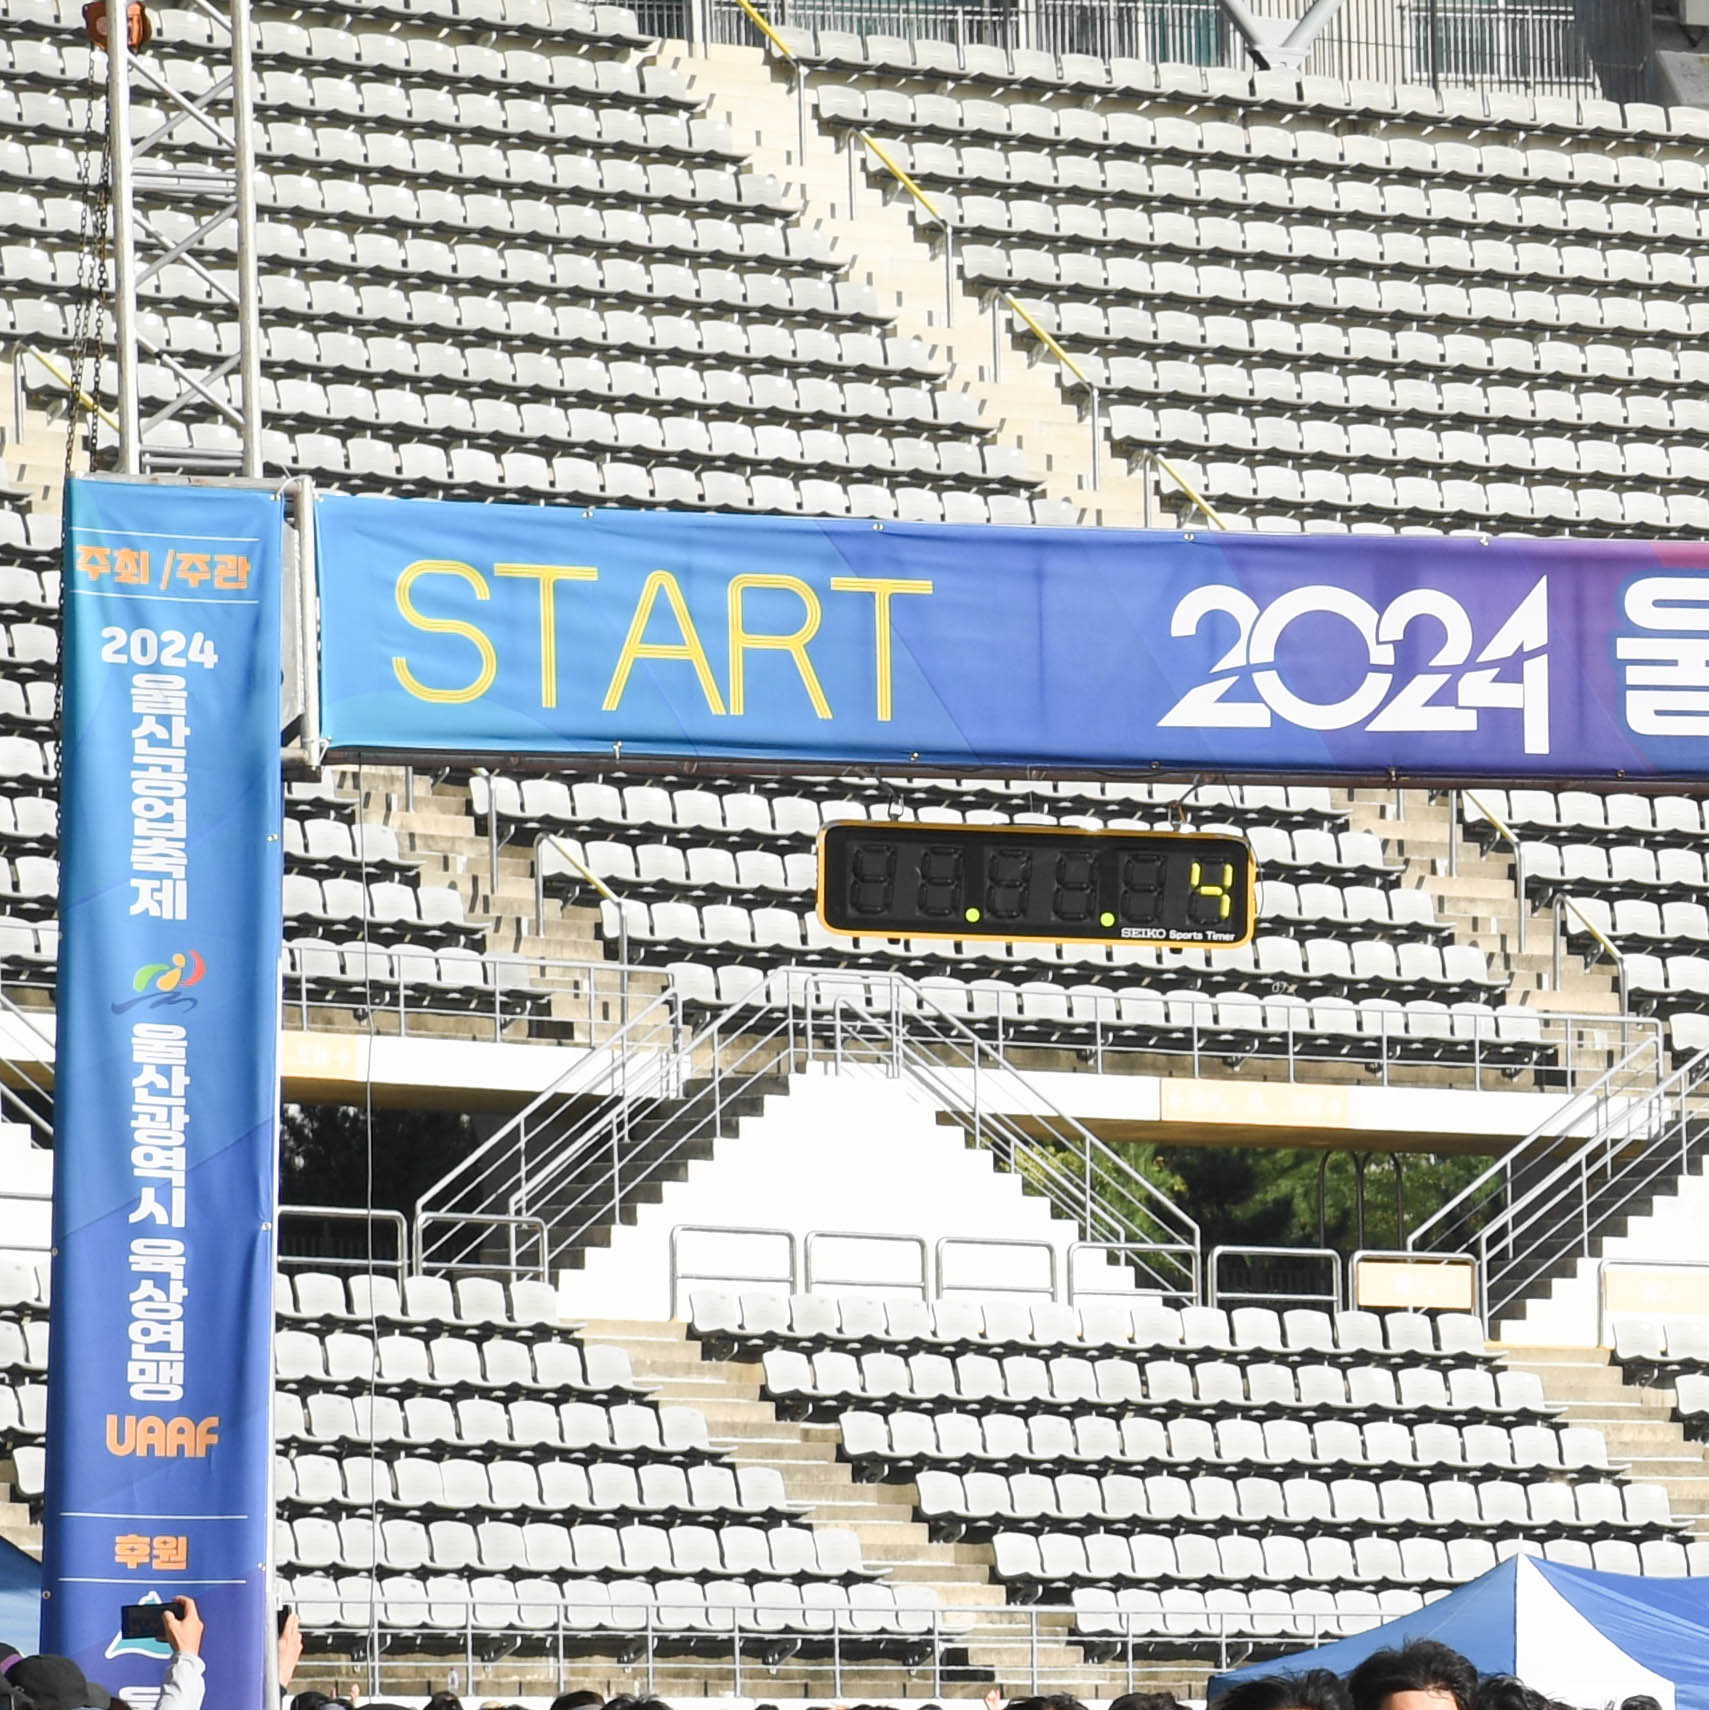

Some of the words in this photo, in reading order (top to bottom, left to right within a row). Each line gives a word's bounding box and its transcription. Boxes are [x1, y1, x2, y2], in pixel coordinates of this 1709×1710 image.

[101, 627, 218, 668] 2024
[392, 560, 933, 722] START
[1156, 575, 1550, 755] 2024
[130, 675, 188, 921] 울산공업축제
[1121, 927, 1166, 938] SEIKO
[1169, 930, 1203, 942] Sports
[1206, 931, 1236, 941] Timer
[128, 1023, 188, 1229] 울산광역시
[127, 1237, 189, 1401] 육상연맹
[106, 1415, 220, 1458] UAAF
[115, 1534, 188, 1571] 후원
